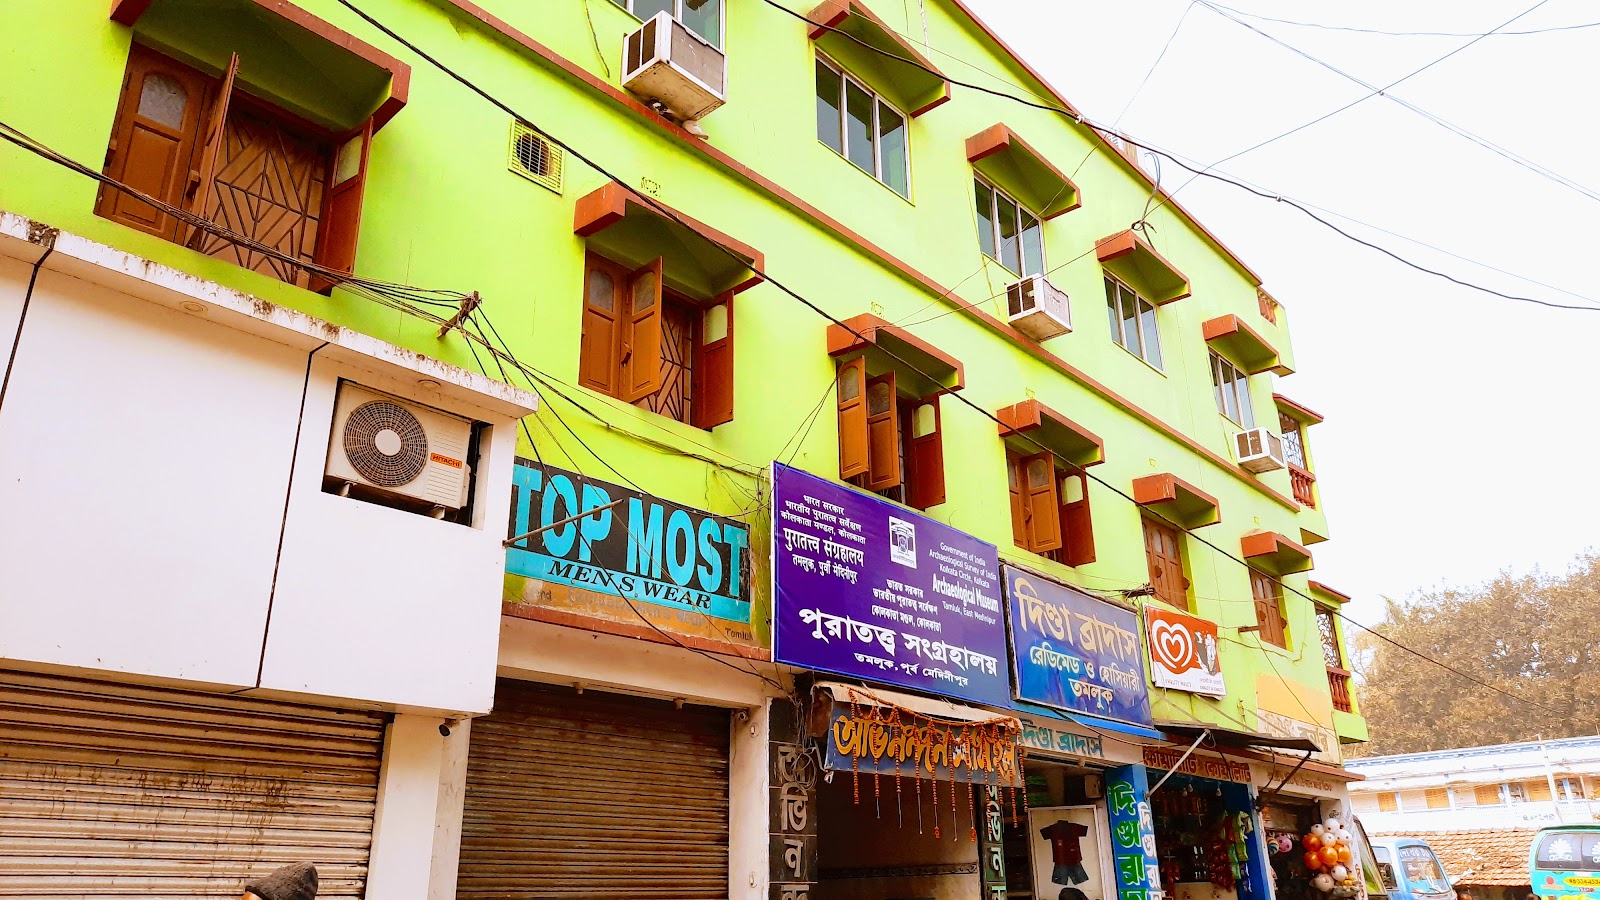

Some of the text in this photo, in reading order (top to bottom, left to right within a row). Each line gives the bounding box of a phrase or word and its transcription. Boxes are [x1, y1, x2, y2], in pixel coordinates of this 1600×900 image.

[432, 455, 460, 467] HITACHI
[803, 494, 845, 516] भारत सरकार
[511, 463, 749, 597] TOP MOST
[822, 536, 864, 568] संग्रहालय
[929, 548, 964, 569] Archaeological
[963, 561, 980, 576] Survey
[985, 570, 997, 581] India
[940, 541, 968, 560] Government
[974, 555, 986, 567] India
[939, 563, 959, 577] Kolkata
[973, 576, 990, 589] Kolkata
[643, 580, 713, 610] WEAR
[904, 584, 924, 599] সরকার
[932, 572, 999, 613] Archaeological Museum
[963, 607, 975, 618] East
[900, 632, 998, 678] সংগ্রহালয়
[1029, 641, 1081, 674] রেডিমেড
[1083, 661, 1095, 679] ও
[922, 667, 969, 688] মেদিনীপুর
[1067, 677, 1114, 710] তমলুক
